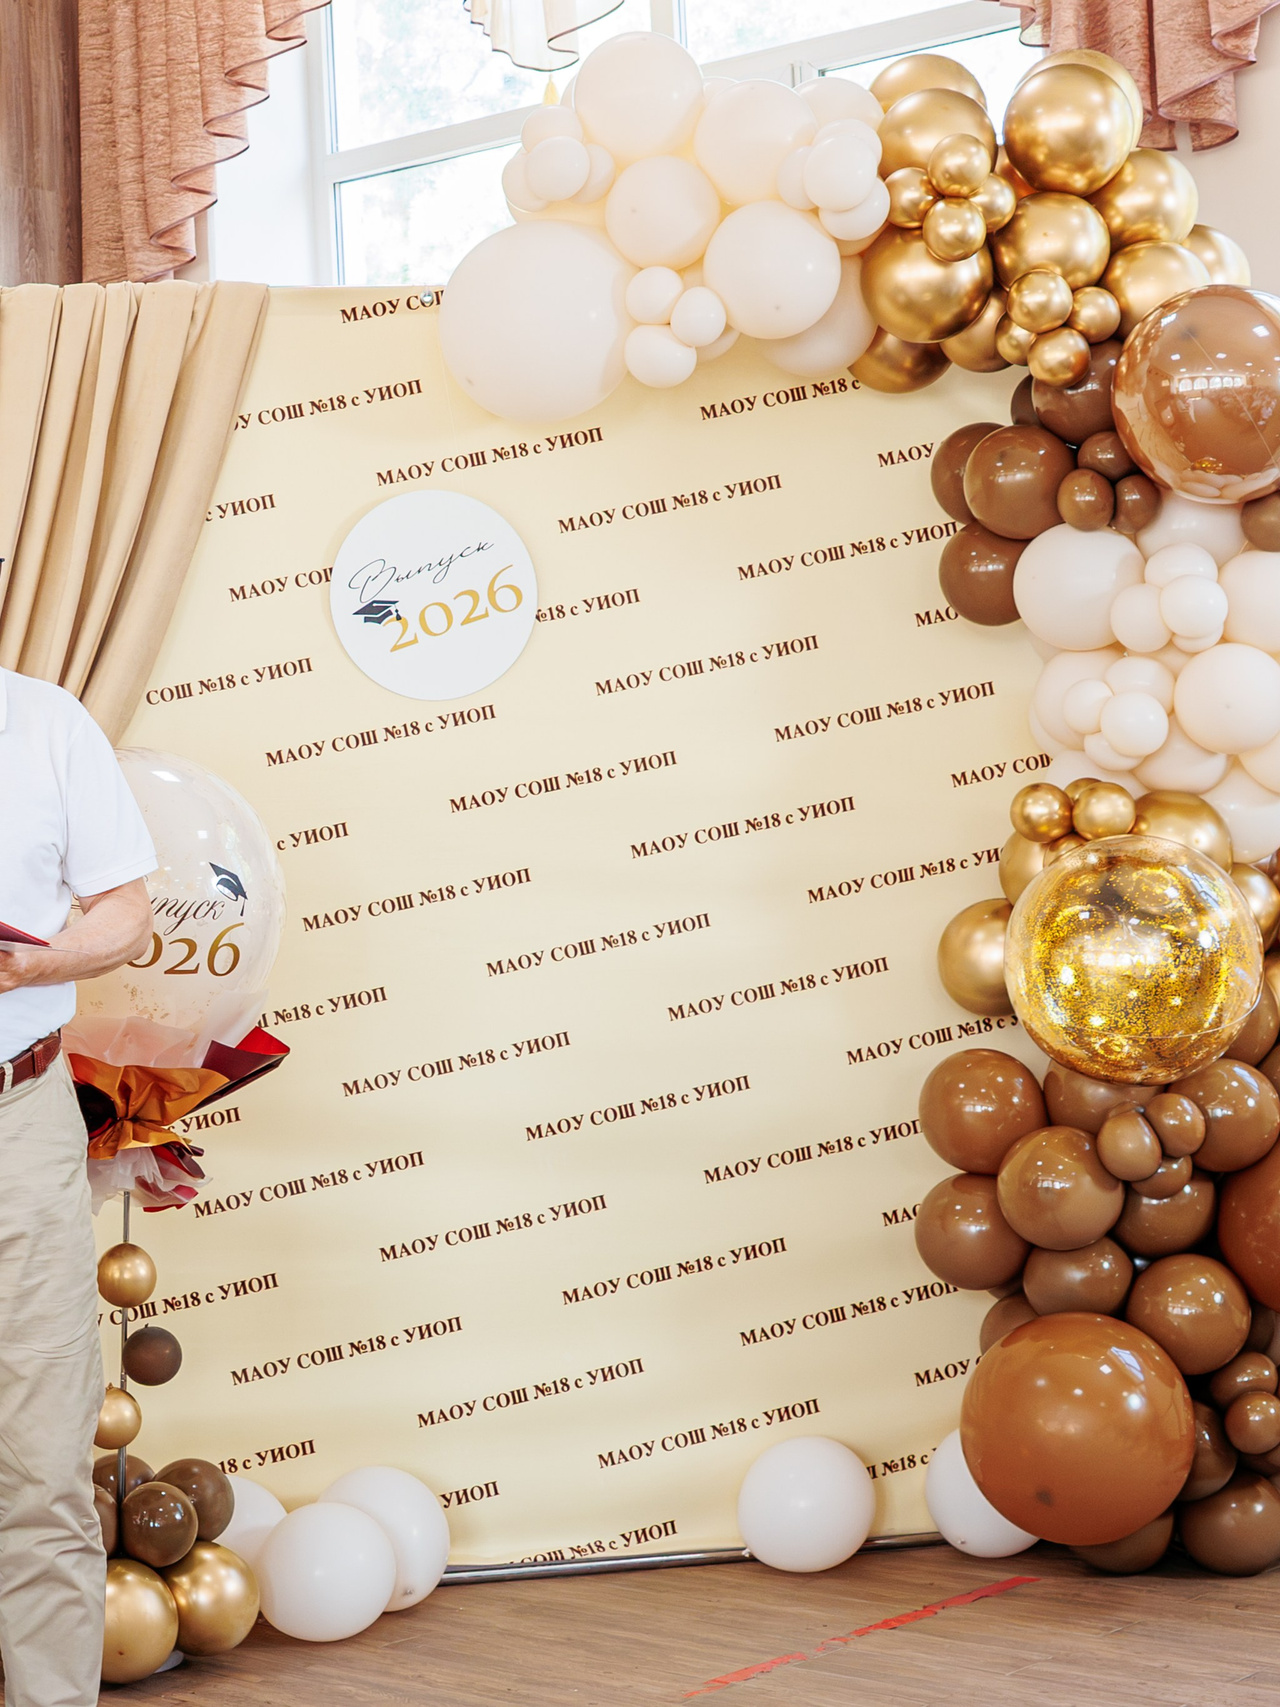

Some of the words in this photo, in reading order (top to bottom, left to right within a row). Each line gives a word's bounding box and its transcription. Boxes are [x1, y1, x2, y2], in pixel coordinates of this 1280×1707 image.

[339, 298, 401, 324] МАОУ
[257, 402, 305, 425] СОШ
[308, 394, 347, 416] №18
[350, 395, 361, 407] с
[362, 379, 423, 404] УИОП
[699, 395, 758, 421] МАОУ
[762, 385, 809, 408] СОШ
[810, 377, 849, 399] №18
[851, 378, 861, 391] с
[375, 460, 435, 487] МАОУ
[440, 450, 488, 473] СОШ
[491, 442, 529, 464] №18
[532, 443, 542, 455] с
[544, 426, 604, 452] УИОП
[876, 442, 934, 468] МАОУ
[215, 493, 276, 520] УИОП
[557, 508, 616, 534] МАОУ
[621, 497, 668, 520] СОШ
[671, 489, 709, 511] №18
[712, 490, 722, 502] с
[723, 474, 782, 500] УИОП
[348, 542, 495, 604] Выпуск
[737, 555, 795, 581] МАОУ
[800, 544, 846, 568] СОШ
[849, 536, 887, 558] №18
[889, 537, 899, 549] с
[228, 576, 289, 603] МАОУ
[382, 564, 523, 653] 2026
[569, 605, 579, 617] с
[581, 588, 640, 614] УИОП
[145, 682, 194, 706] СОШ
[197, 673, 237, 696] №18
[240, 675, 250, 686] с
[252, 657, 313, 683] УИОП
[594, 669, 653, 697] МАОУ
[658, 659, 705, 682] СОШ
[708, 650, 746, 673] №18
[749, 652, 759, 663] с
[760, 634, 819, 661] УИОП
[264, 740, 326, 767] МАОУ
[331, 729, 379, 753] СОШ
[382, 720, 421, 743] №18
[424, 721, 434, 733] с
[437, 704, 497, 730] УИОП
[773, 716, 832, 743] МАОУ
[836, 705, 883, 728] СОШ
[886, 697, 923, 719] №18
[926, 698, 936, 710] с
[937, 680, 995, 707] УИОП
[448, 786, 509, 814] МАОУ
[514, 775, 561, 799] СОШ
[564, 767, 603, 789] №18
[606, 768, 616, 779] с
[618, 750, 678, 776] УИОП
[950, 761, 1007, 789] МАОУ
[276, 839, 286, 851] с
[288, 821, 349, 848] УИОП
[630, 832, 689, 860] МАОУ
[694, 821, 741, 845] СОШ
[743, 812, 782, 835] №18
[785, 813, 795, 825] с
[796, 796, 856, 822] УИОП
[301, 904, 362, 932] МАОУ
[367, 893, 415, 917] СОШ
[418, 884, 457, 907] №18
[460, 885, 470, 897] с
[471, 867, 532, 894] УИОП
[807, 877, 865, 904] МАОУ
[870, 866, 916, 889] СОШ
[919, 857, 956, 879] №18
[959, 858, 969, 870] с
[151, 896, 226, 937] пуск
[125, 922, 245, 977] 026
[485, 950, 545, 978] МАОУ
[550, 938, 597, 962] СОШ
[599, 929, 638, 952] №18
[641, 930, 651, 942] с
[652, 912, 711, 939] УИОП
[272, 1003, 312, 1026] №18
[315, 1004, 326, 1016] с
[326, 986, 388, 1013] УИОП
[667, 994, 725, 1022] МАОУ
[730, 982, 776, 1007] СОШ
[779, 973, 817, 996] №18
[819, 974, 830, 986] с
[831, 956, 890, 983] УИОП
[341, 1069, 402, 1098] МАОУ
[407, 1058, 455, 1082] СОШ
[457, 1048, 496, 1071] №18
[499, 1049, 510, 1061] с
[510, 1031, 571, 1058] УИОП
[845, 1037, 904, 1066] МАОУ
[908, 1026, 954, 1050] СОШ
[956, 1016, 994, 1040] №18
[995, 1017, 1006, 1030] с
[179, 1106, 242, 1134] УИОП
[525, 1113, 585, 1142] МАОУ
[589, 1102, 637, 1126] СОШ
[639, 1092, 678, 1115] №18
[680, 1093, 691, 1105] с
[691, 1074, 751, 1102] УИОП
[193, 1190, 254, 1219] МАОУ
[259, 1178, 308, 1203] СОШ
[310, 1168, 349, 1192] №18
[352, 1169, 363, 1181] с
[363, 1150, 425, 1178] УИОП
[703, 1156, 762, 1185] МАОУ
[766, 1145, 813, 1169] СОШ
[816, 1135, 854, 1158] №18
[857, 1136, 867, 1148] с
[378, 1233, 439, 1263] МАОУ
[444, 1222, 492, 1247] СОШ
[495, 1212, 534, 1235] №18
[536, 1213, 547, 1225] с
[547, 1194, 608, 1222] УИОП
[161, 1291, 202, 1315] №18
[204, 1292, 215, 1304] с
[217, 1272, 280, 1301] УИОП
[561, 1277, 621, 1306] МАОУ
[626, 1265, 673, 1289] СОШ
[675, 1255, 714, 1278] №18
[716, 1256, 727, 1268] с
[728, 1236, 787, 1265] УИОП
[739, 1317, 797, 1347] МАОУ
[801, 1305, 848, 1330] СОШ
[850, 1295, 887, 1319] №18
[889, 1296, 900, 1308] с
[229, 1356, 291, 1387] МАОУ
[296, 1344, 345, 1370] СОШ
[347, 1334, 387, 1358] №18
[390, 1335, 400, 1347] с
[402, 1316, 463, 1344] УИОП
[913, 1358, 971, 1388] МАОУ
[417, 1399, 477, 1429] МАОУ
[482, 1387, 530, 1412] СОШ
[532, 1377, 571, 1400] №18
[573, 1377, 584, 1389] с
[585, 1357, 645, 1386] УИОП
[241, 1458, 253, 1470] с
[254, 1439, 316, 1467] УИОП
[597, 1439, 655, 1469] МАОУ
[660, 1427, 707, 1452] СОШ
[709, 1417, 748, 1440] №18
[750, 1418, 761, 1430] с
[761, 1398, 821, 1426] УИОП
[881, 1453, 917, 1477] №18
[919, 1453, 930, 1466] с
[438, 1480, 500, 1509] УИОП
[608, 1540, 619, 1551] с
[618, 1519, 678, 1548] УИОП
